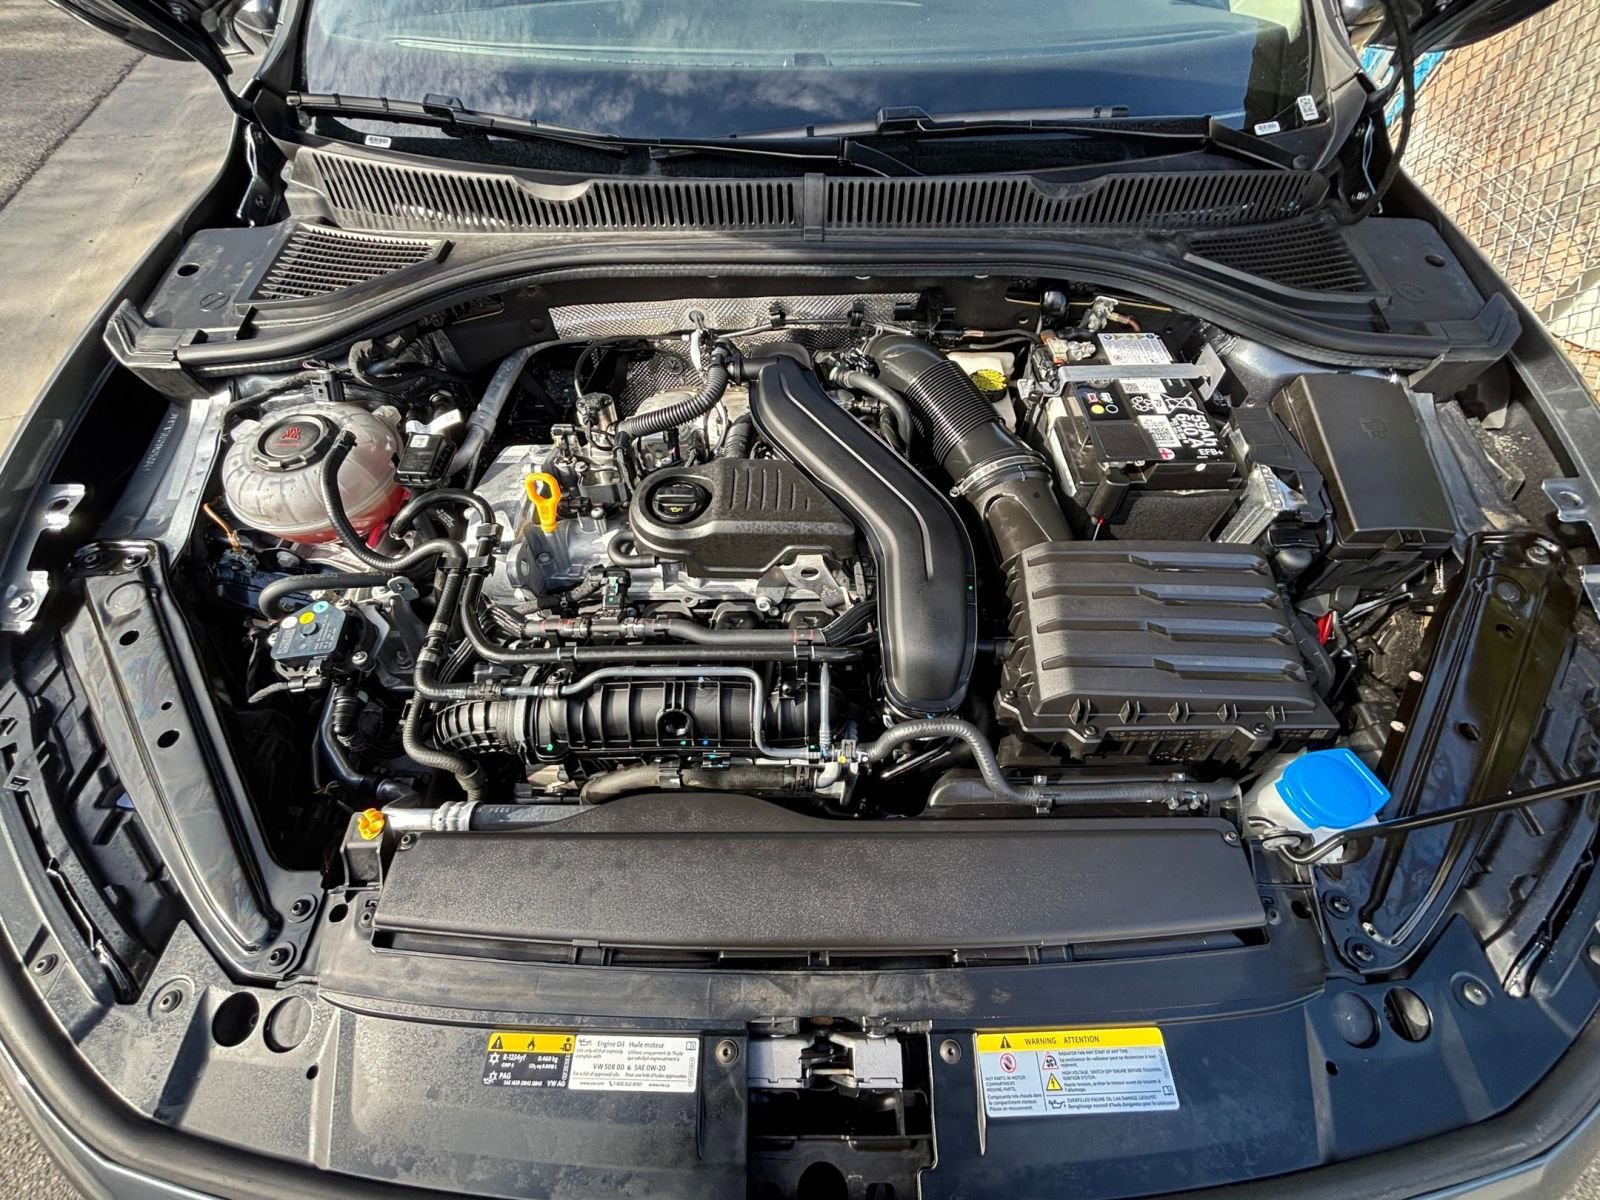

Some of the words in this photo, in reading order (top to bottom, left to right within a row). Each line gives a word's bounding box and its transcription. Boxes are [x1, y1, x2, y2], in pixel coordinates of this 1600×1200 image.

[1176, 414, 1198, 435] 640
[1190, 414, 1218, 447] 59Ah
[503, 1054, 527, 1063] R-1234yf
